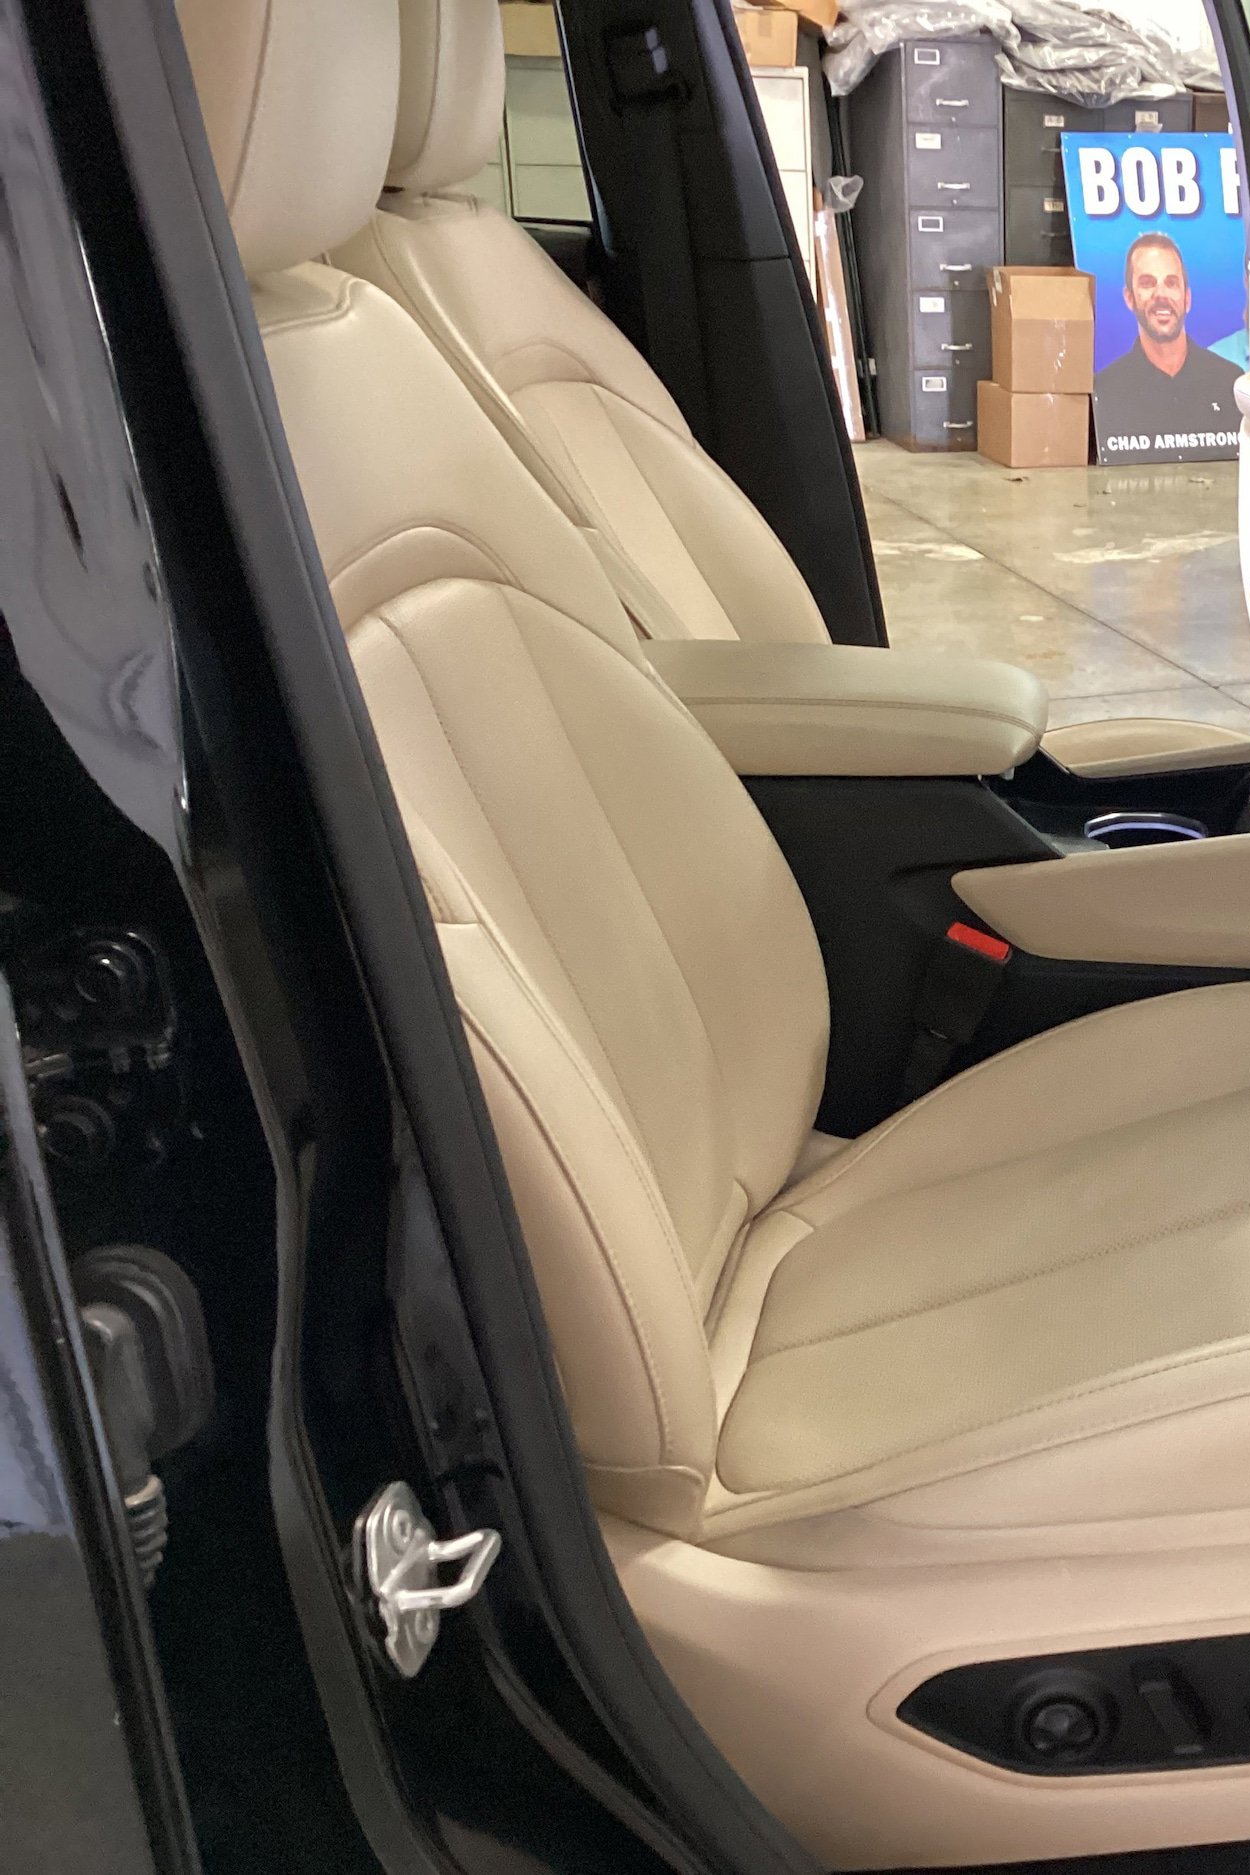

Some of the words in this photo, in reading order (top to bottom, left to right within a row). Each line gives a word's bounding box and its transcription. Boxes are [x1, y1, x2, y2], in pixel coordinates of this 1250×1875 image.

[1078, 147, 1200, 215] BOB
[1107, 435, 1151, 451] CHAD
[1154, 432, 1241, 449] ARMSTRON
